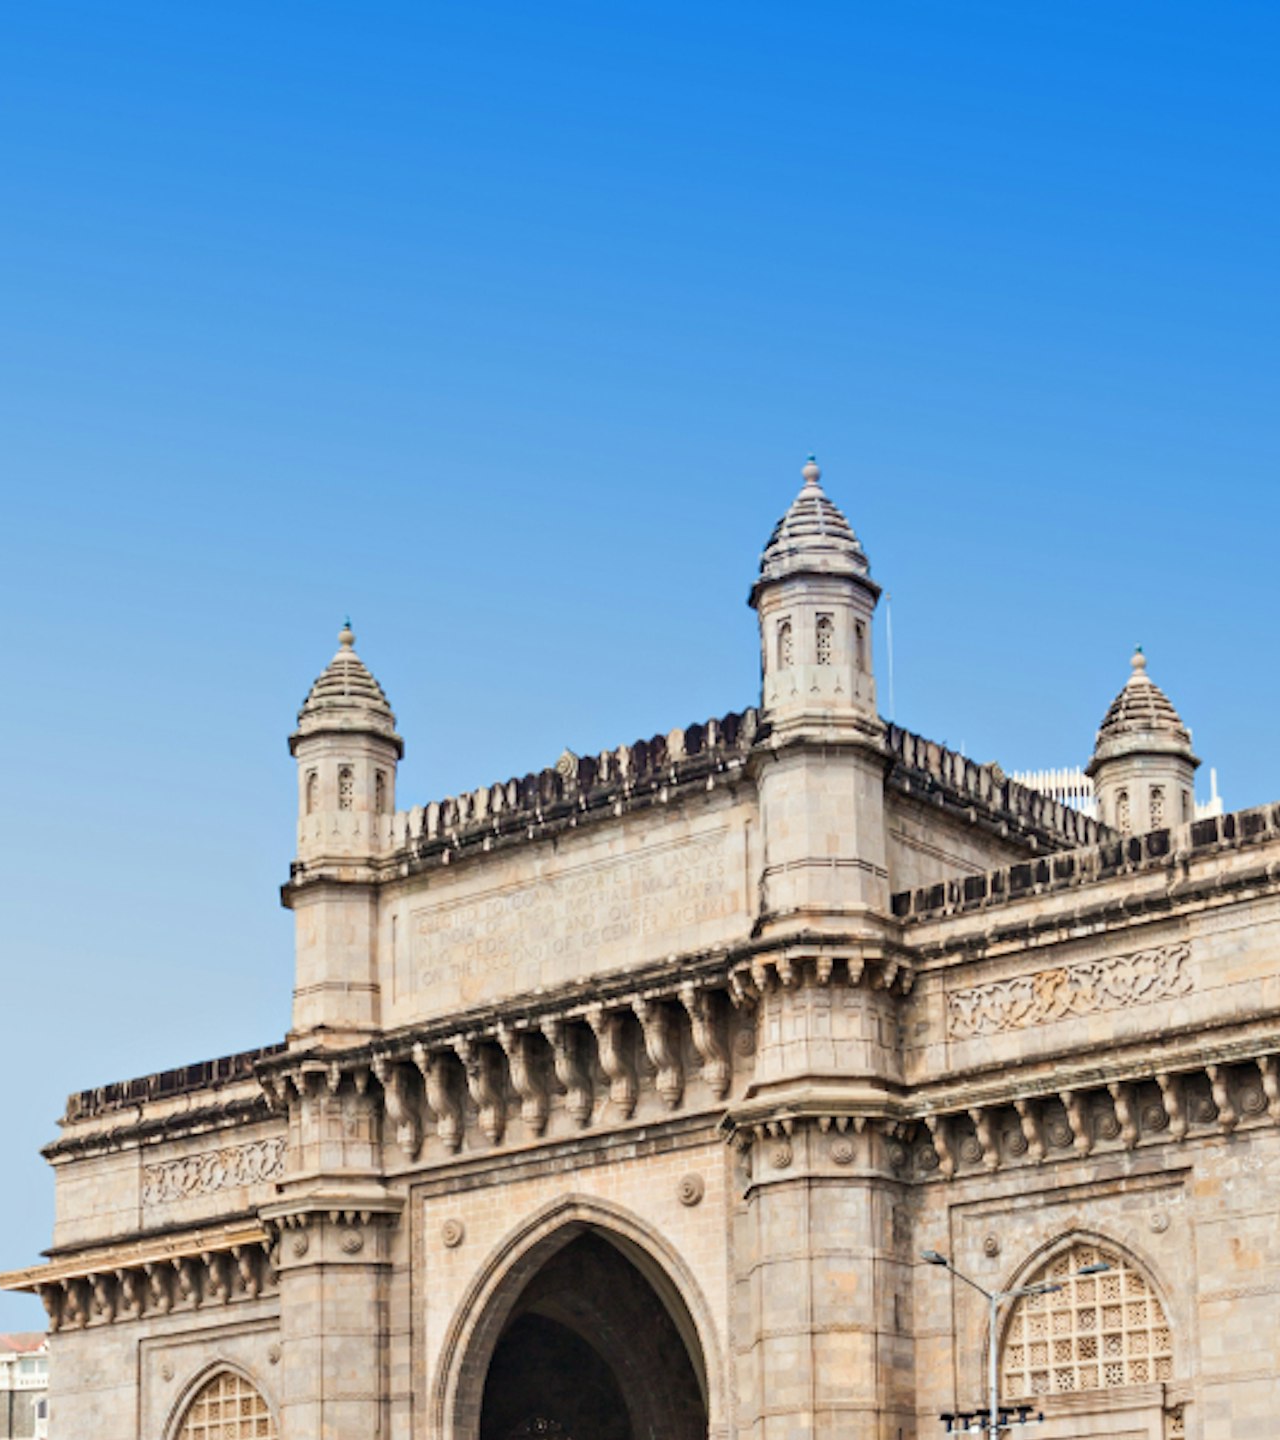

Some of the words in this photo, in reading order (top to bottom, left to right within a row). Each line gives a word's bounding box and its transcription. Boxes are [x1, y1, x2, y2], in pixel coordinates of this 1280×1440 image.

[439, 925, 474, 946] INDIA
[486, 918, 502, 934] OF
[565, 886, 628, 914] IMPERIAL
[642, 859, 724, 895] MAJESTIES
[464, 931, 524, 958] GEORGE
[566, 913, 595, 931] AND
[609, 896, 664, 922] QUEEN
[677, 879, 724, 901] MARY
[485, 900, 504, 918] TO
[629, 859, 652, 880] THE
[422, 968, 441, 986] ON
[449, 960, 473, 980] THE
[484, 944, 542, 972] SECOND
[552, 934, 573, 955] OF
[581, 913, 657, 948] DECEMBER
